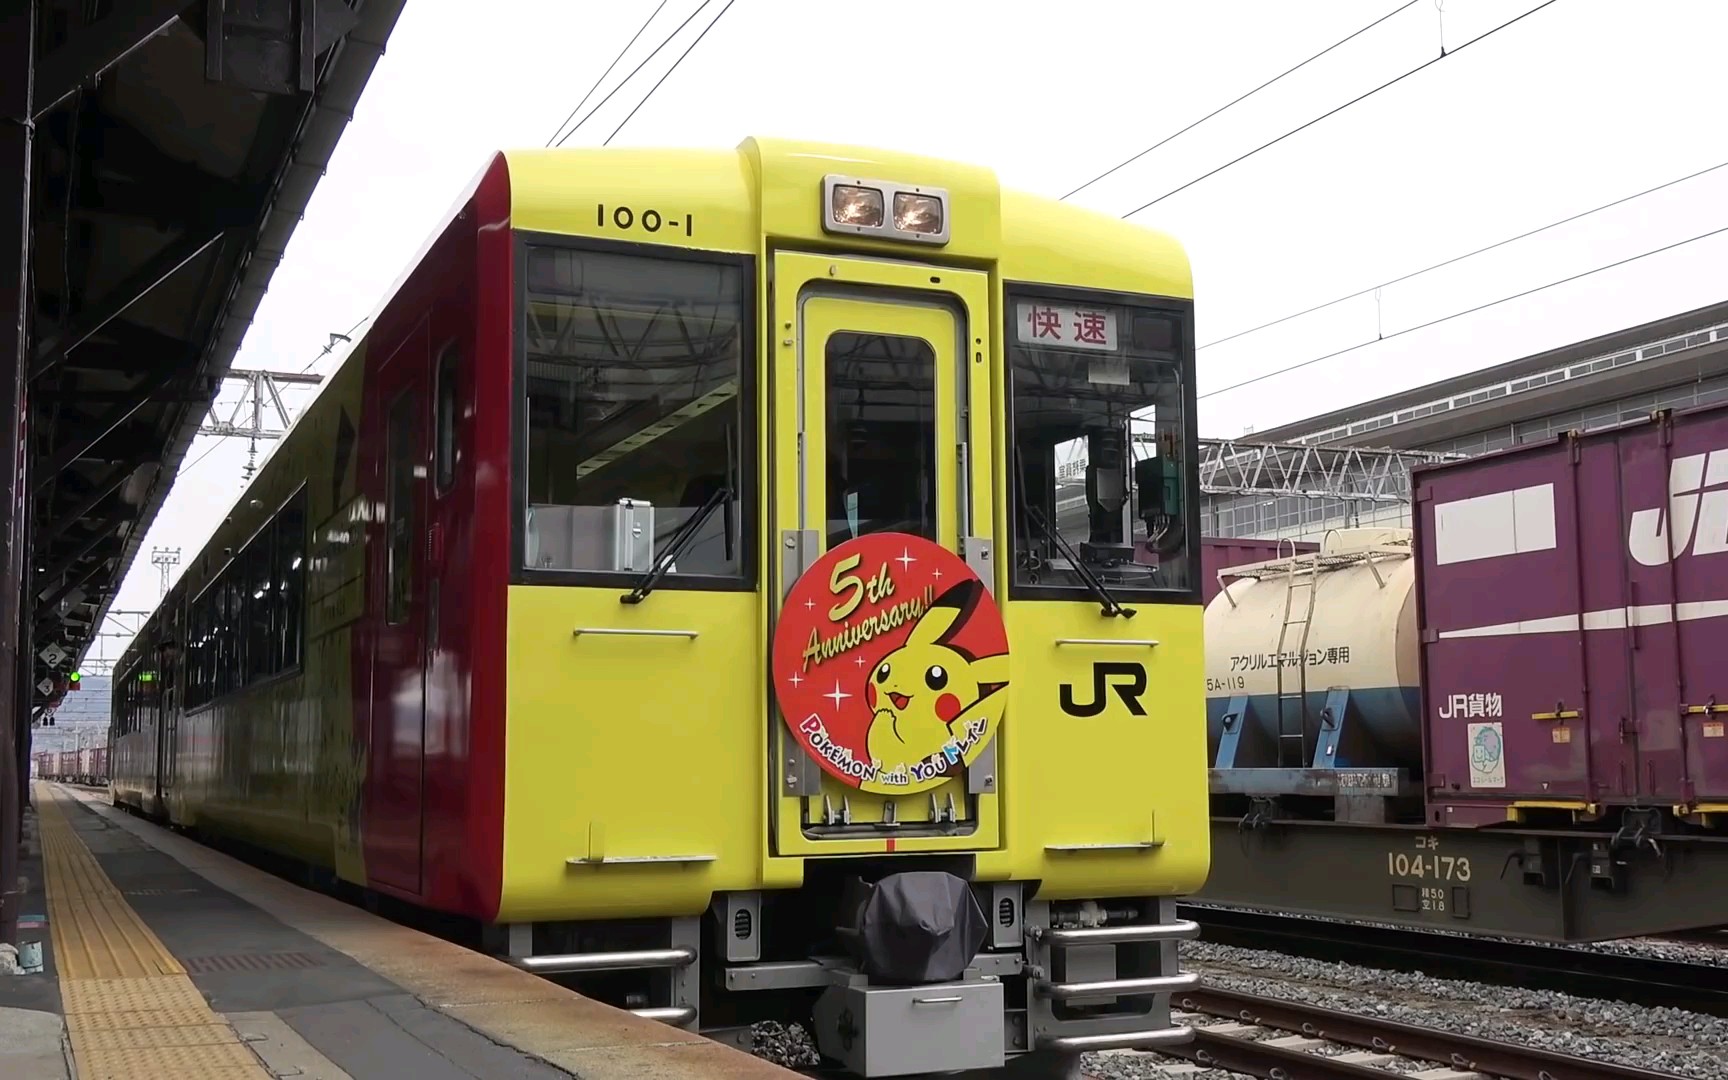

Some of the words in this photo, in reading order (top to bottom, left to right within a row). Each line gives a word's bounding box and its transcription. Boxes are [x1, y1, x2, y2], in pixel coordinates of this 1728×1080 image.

[598, 204, 692, 237] 100-1
[1028, 305, 1107, 345] 快速
[828, 552, 895, 622] 5th
[802, 584, 934, 673] Anniversary!!
[1060, 662, 1147, 717] JR
[1204, 676, 1244, 691] 5A-119
[1439, 692, 1502, 719] JR貨物
[881, 771, 908, 785] with
[911, 757, 947, 782] YOU
[942, 717, 988, 766] トレイン
[1415, 835, 1439, 850] コキ
[1388, 852, 1471, 882] 104-173
